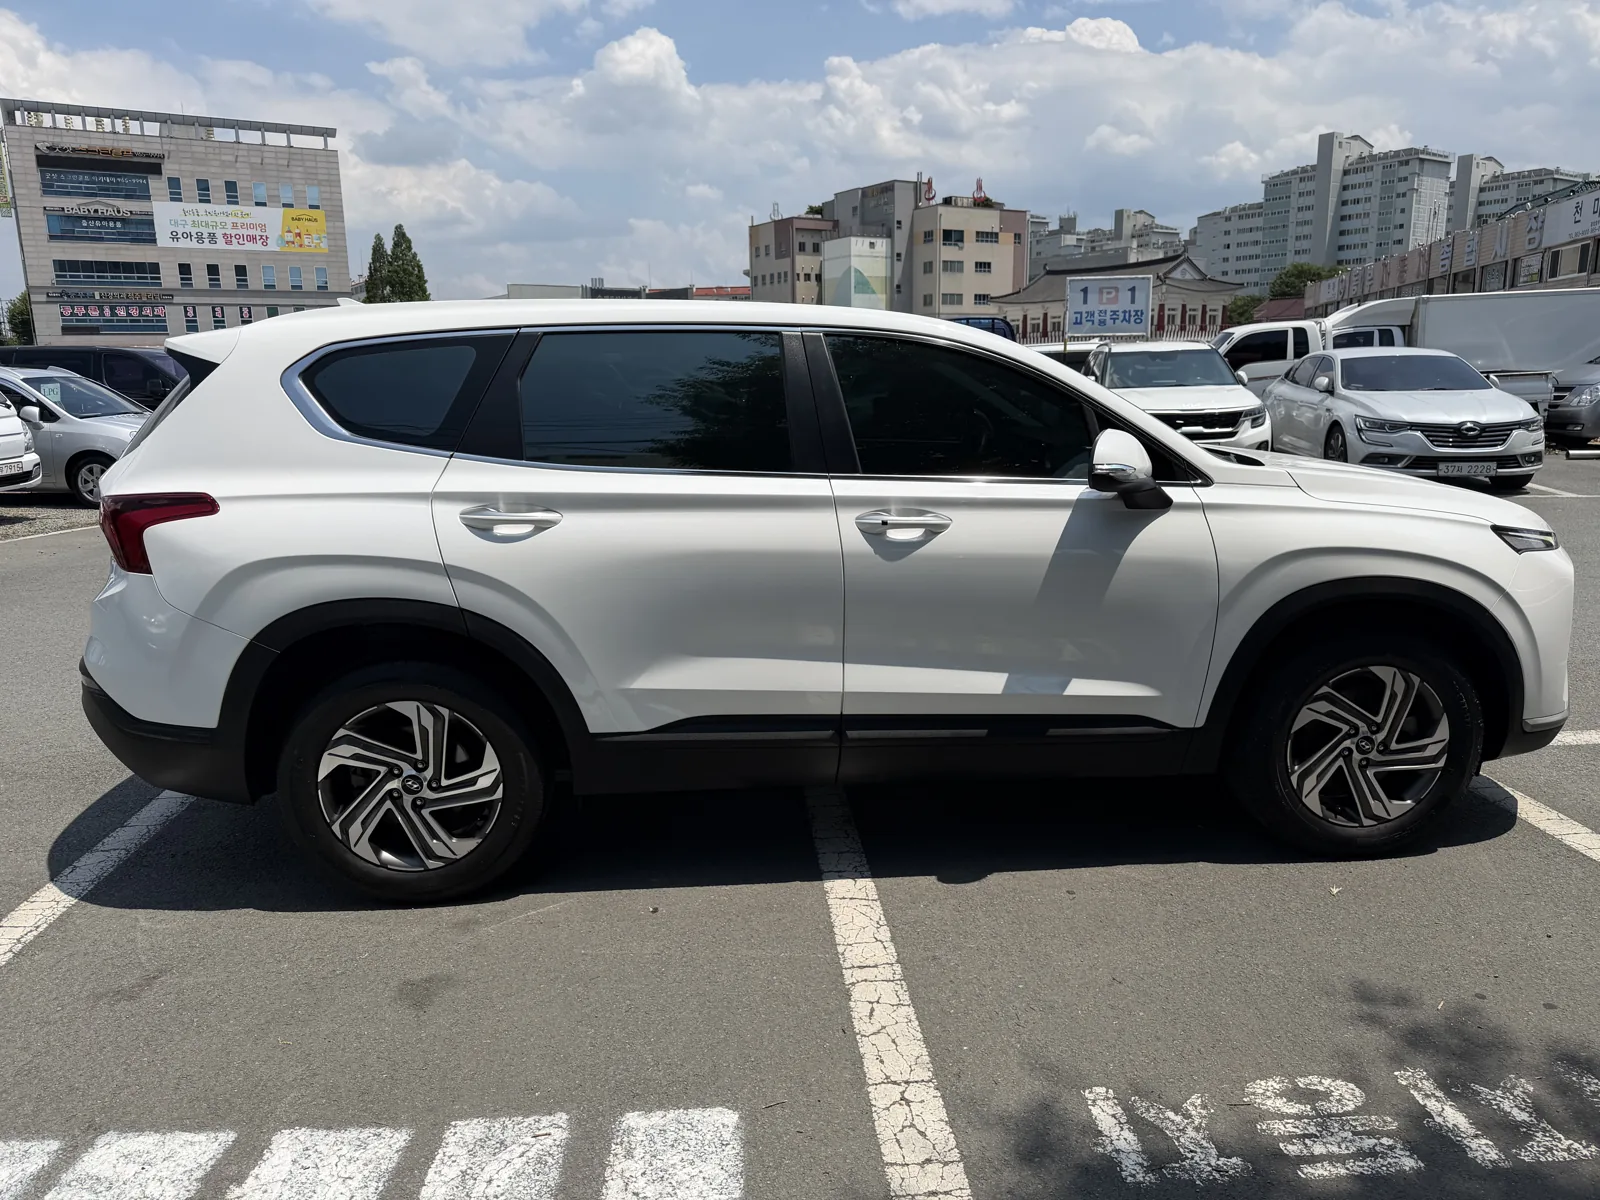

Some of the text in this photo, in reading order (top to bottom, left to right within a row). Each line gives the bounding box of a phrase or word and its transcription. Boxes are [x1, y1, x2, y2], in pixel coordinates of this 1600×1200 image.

[64, 205, 131, 217] BABY HAUS
[169, 218, 267, 233] 대구 최대규모 프리미엄
[169, 230, 270, 247] 유아용품 할인매장
[1080, 286, 1089, 305] 1
[1127, 285, 1136, 305] 1
[1466, 464, 1492, 474] 2228
